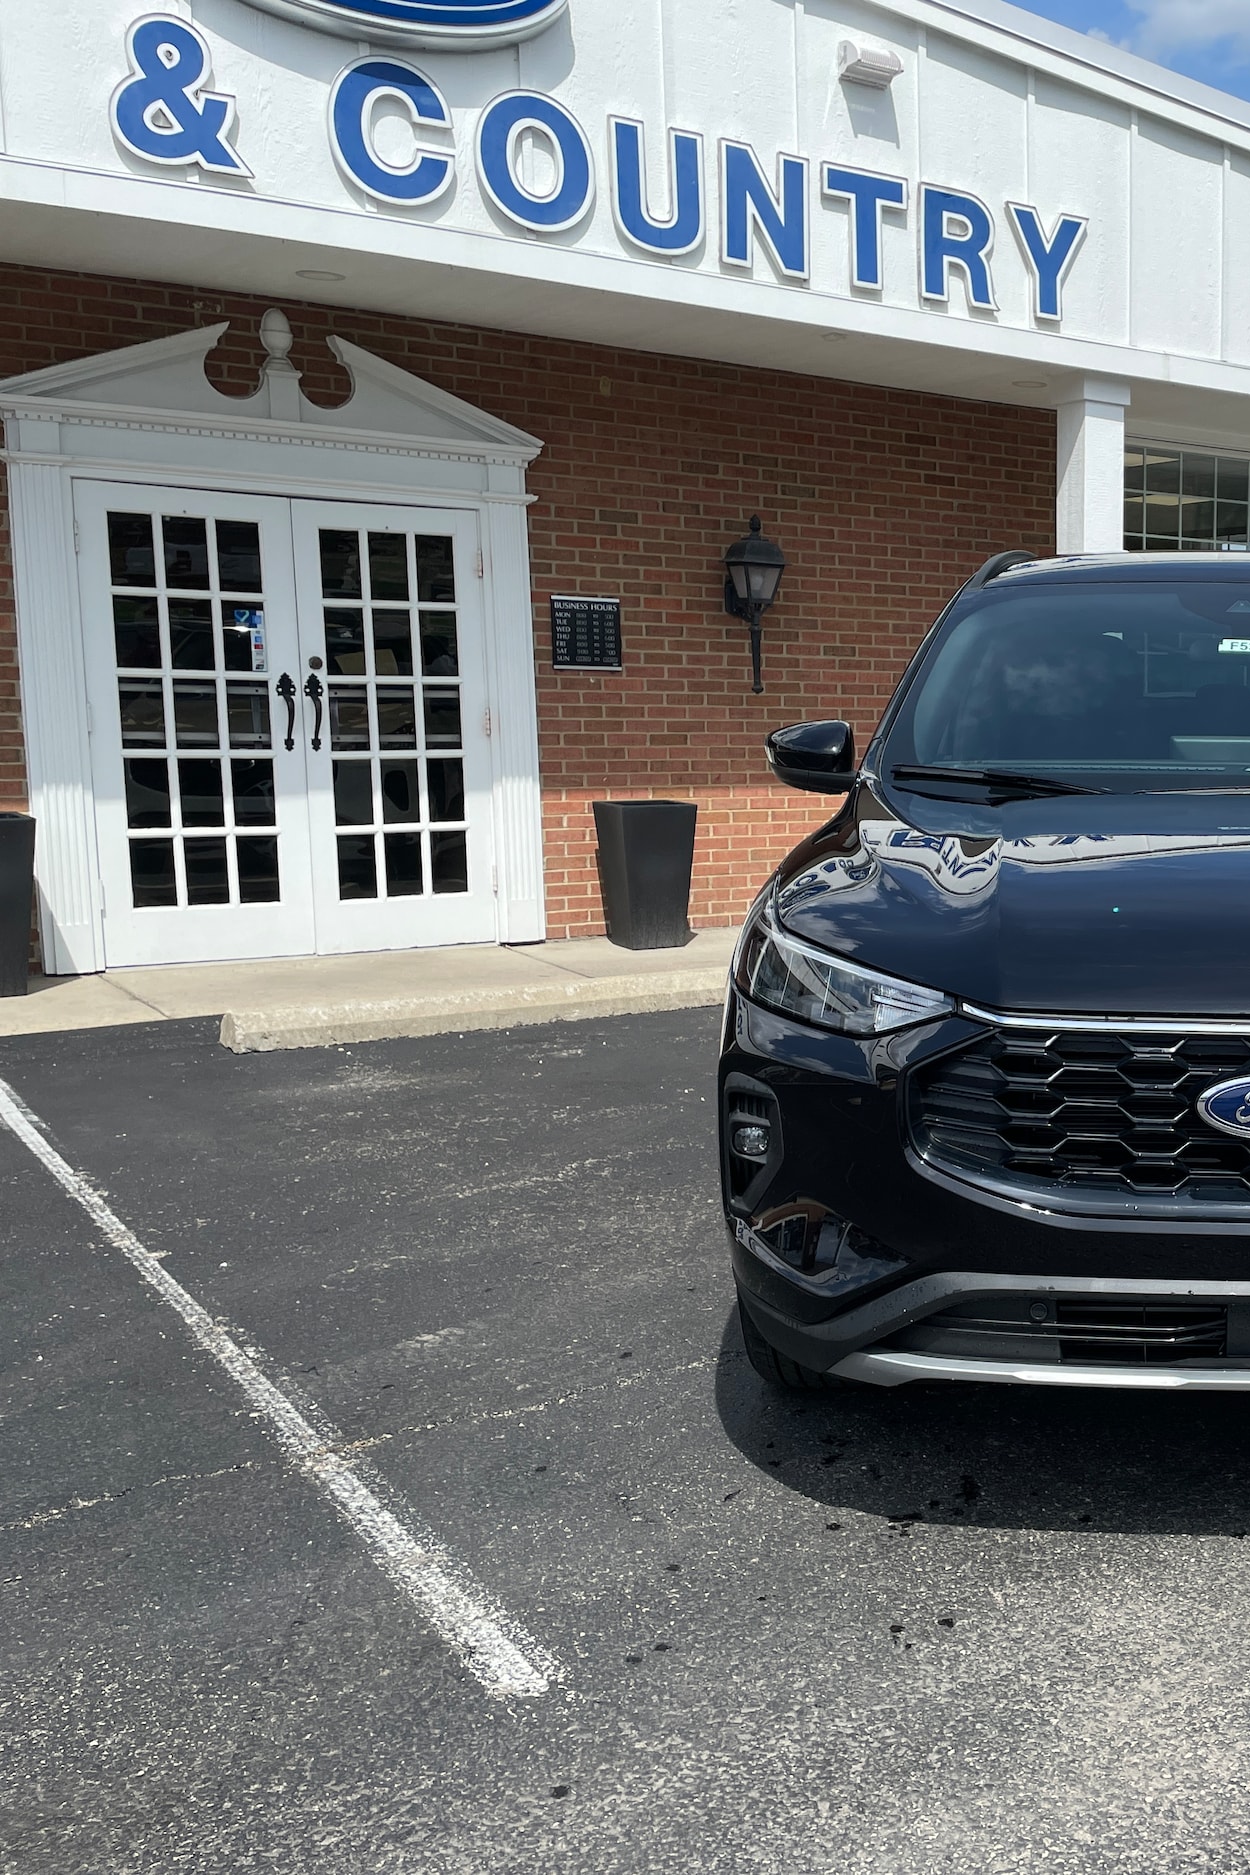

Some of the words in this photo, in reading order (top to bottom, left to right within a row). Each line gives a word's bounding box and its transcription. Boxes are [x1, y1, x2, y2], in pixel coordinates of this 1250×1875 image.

[109, 13, 255, 178] &
[328, 55, 1089, 321] COUNTRY
[554, 601, 589, 610] BUSINESS
[590, 603, 618, 611] HOURS
